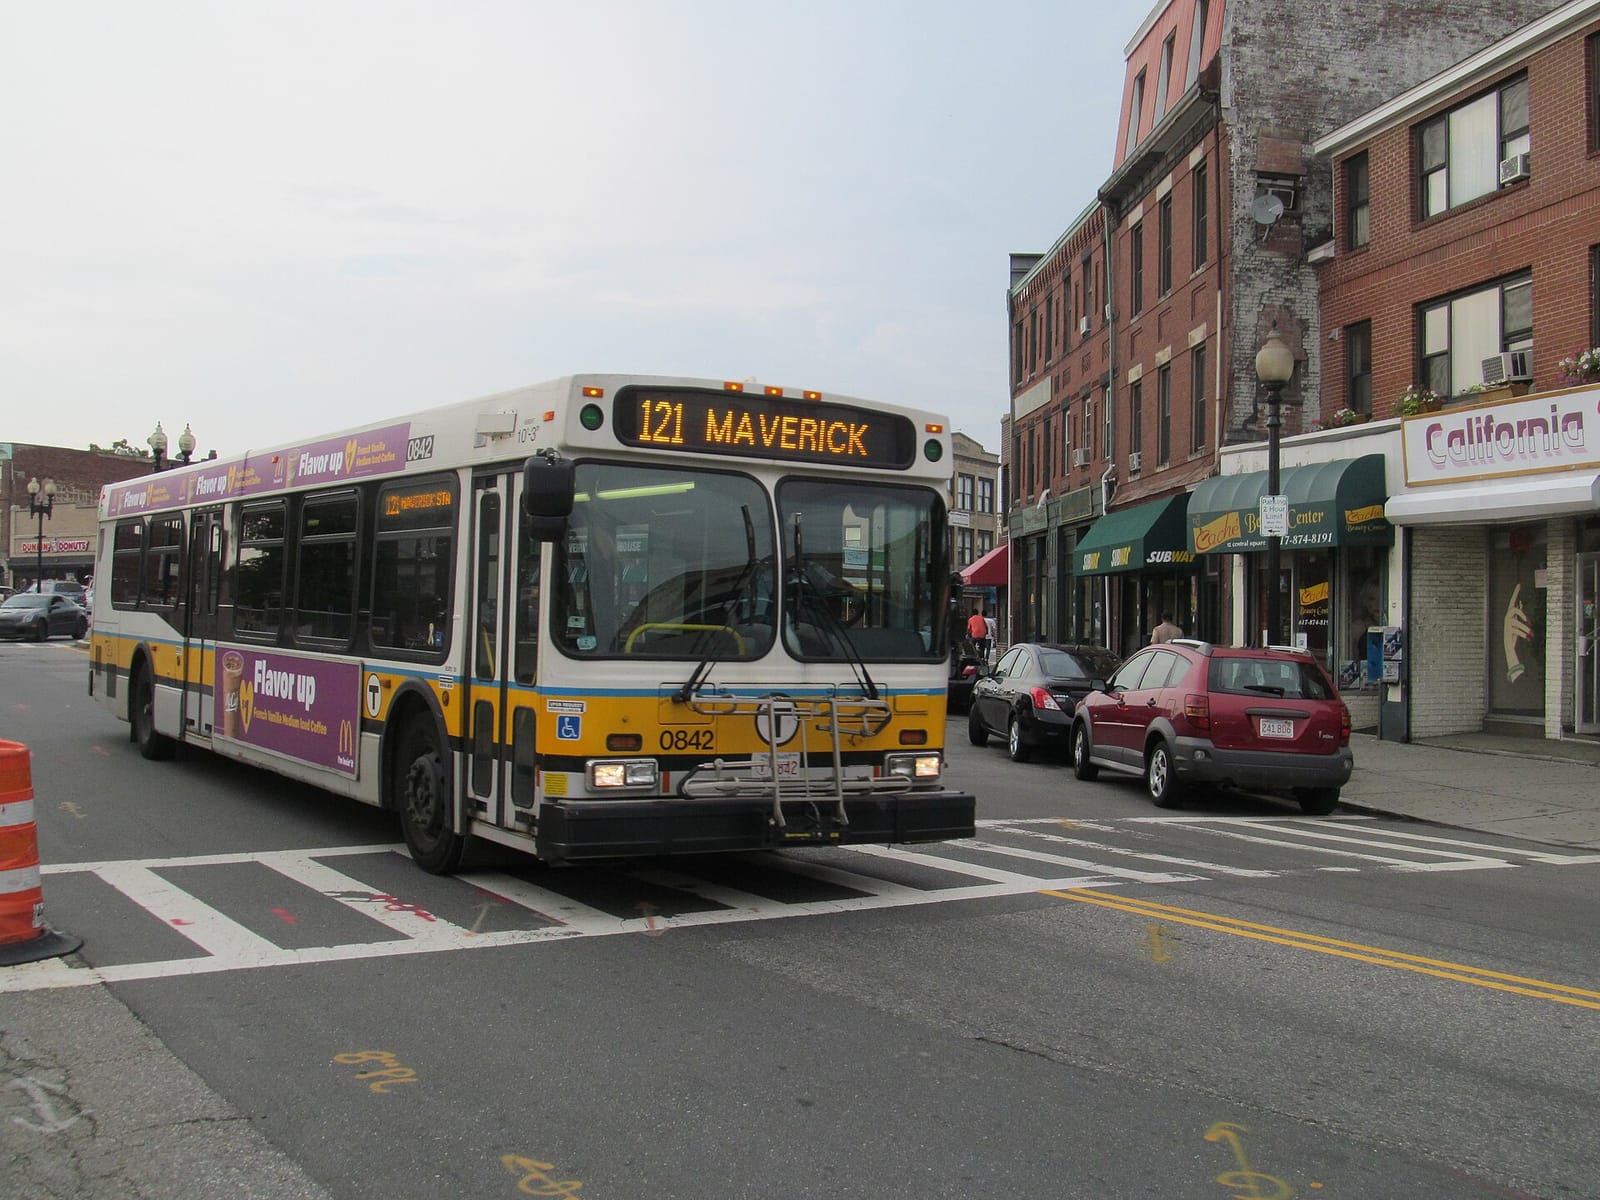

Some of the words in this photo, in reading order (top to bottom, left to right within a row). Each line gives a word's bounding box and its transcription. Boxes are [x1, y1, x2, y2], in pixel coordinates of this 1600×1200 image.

[639, 399, 684, 444] 121
[705, 408, 869, 456] MAVERICK
[1425, 404, 1586, 465] California
[407, 437, 433, 461] 0842
[298, 452, 328, 477] Flavor
[329, 450, 344, 475] up
[196, 475, 218, 496] Flavor
[217, 474, 227, 495] up
[1287, 508, 1324, 529] Center
[22, 543, 50, 552] DUNIN'
[58, 541, 86, 551] DONUTS
[1279, 532, 1332, 546] 17-874-8191
[1146, 551, 1196, 563] SUBWAY
[254, 660, 295, 700] Flavor
[296, 674, 316, 711] up
[368, 685, 380, 710] T
[1261, 724, 1275, 733] 241
[659, 730, 714, 750] 0842
